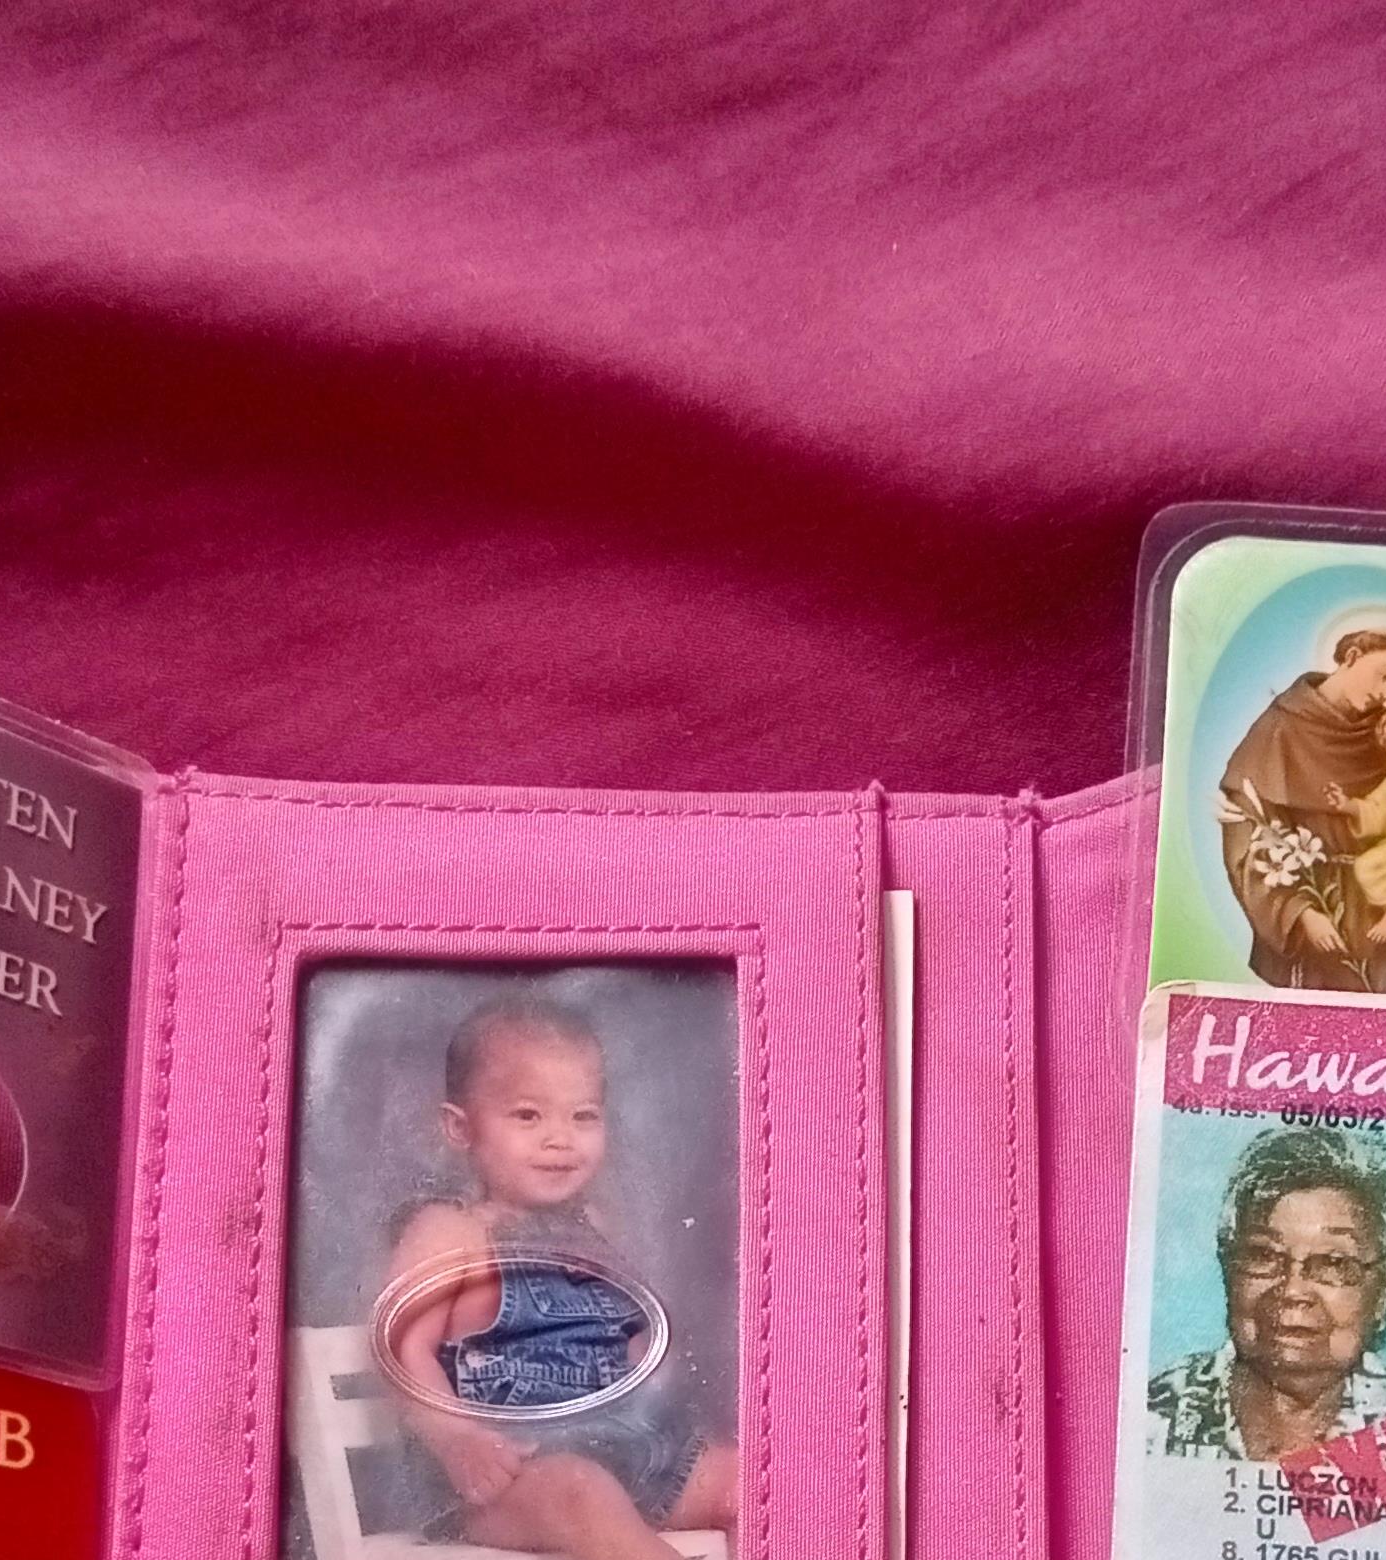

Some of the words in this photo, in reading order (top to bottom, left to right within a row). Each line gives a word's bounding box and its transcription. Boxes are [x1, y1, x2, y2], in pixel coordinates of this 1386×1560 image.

[1225, 1468, 1247, 1489] 1.
[1223, 1492, 1246, 1514] 2.
[1256, 1518, 1276, 1541] U
